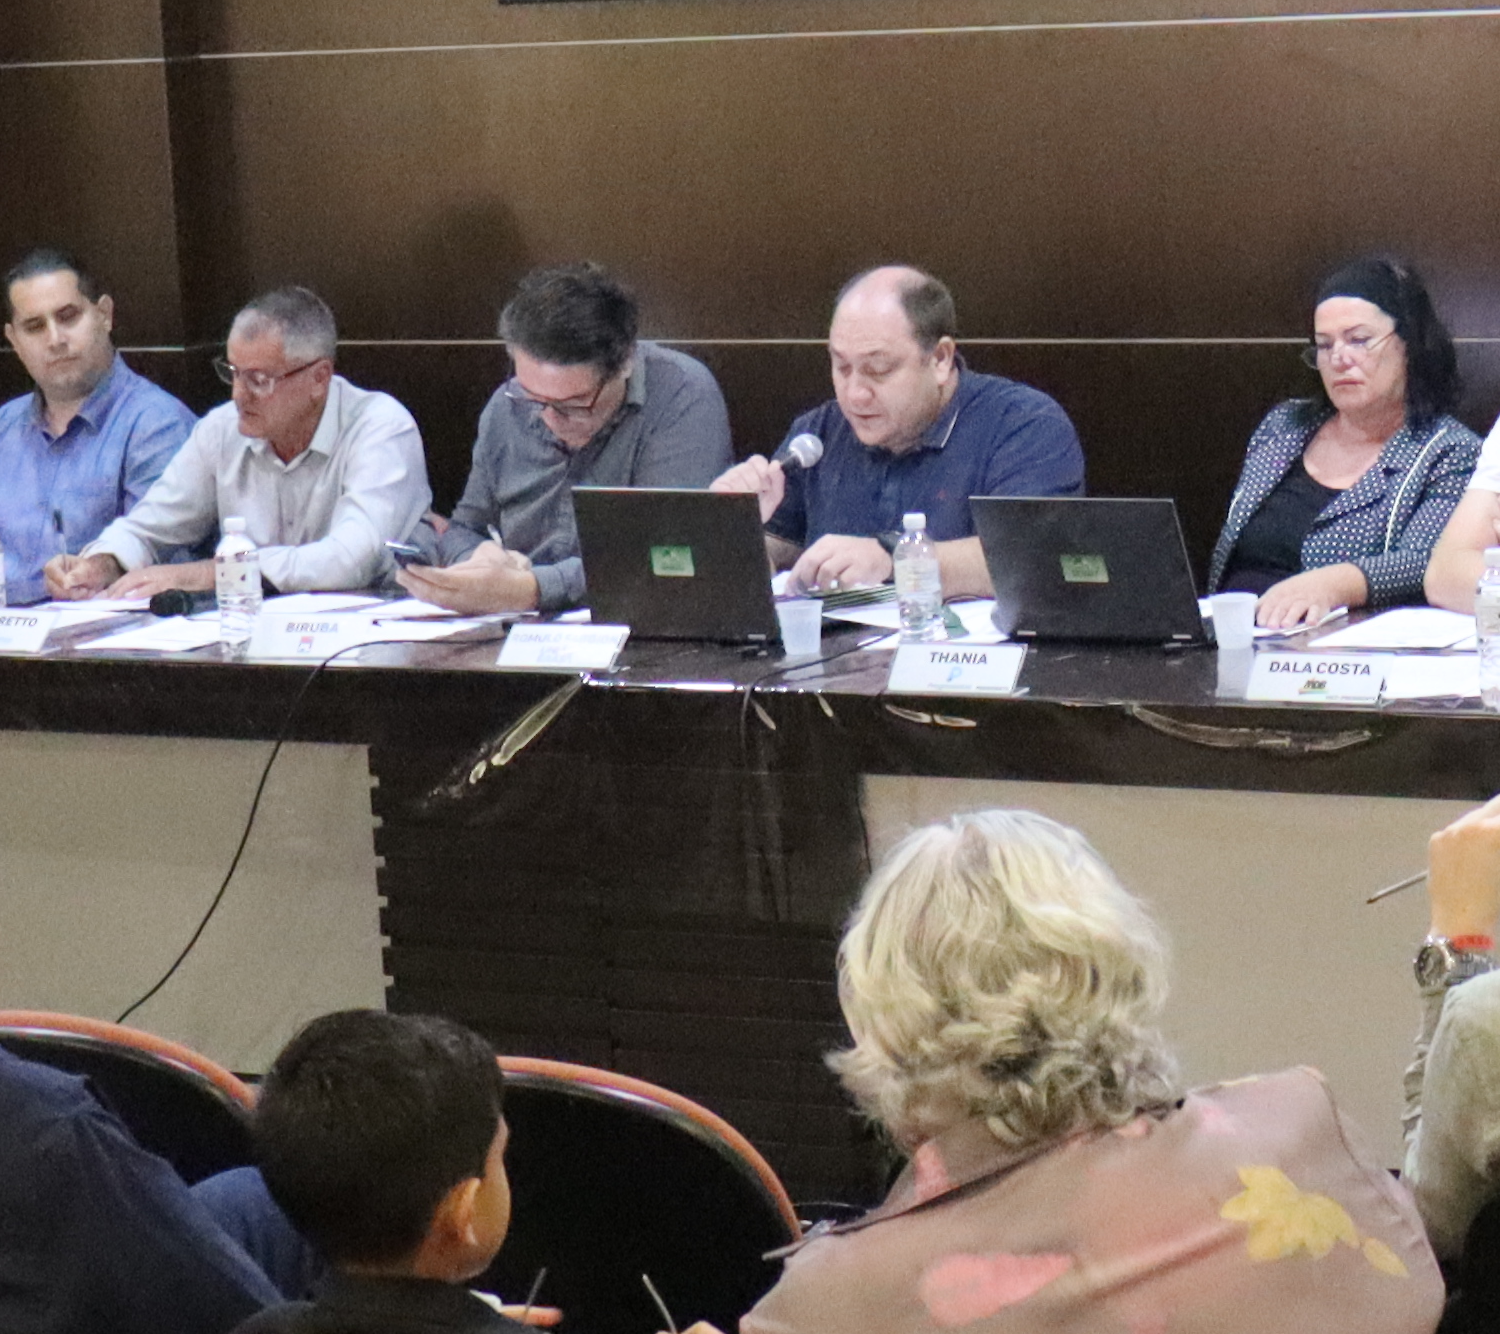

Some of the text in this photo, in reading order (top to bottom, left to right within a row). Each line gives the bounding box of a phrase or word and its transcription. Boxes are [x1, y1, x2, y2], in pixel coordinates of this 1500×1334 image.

[285, 622, 338, 632] BIRUBA
[930, 652, 987, 664] THANIA
[1269, 661, 1370, 675] DALA COSTA
